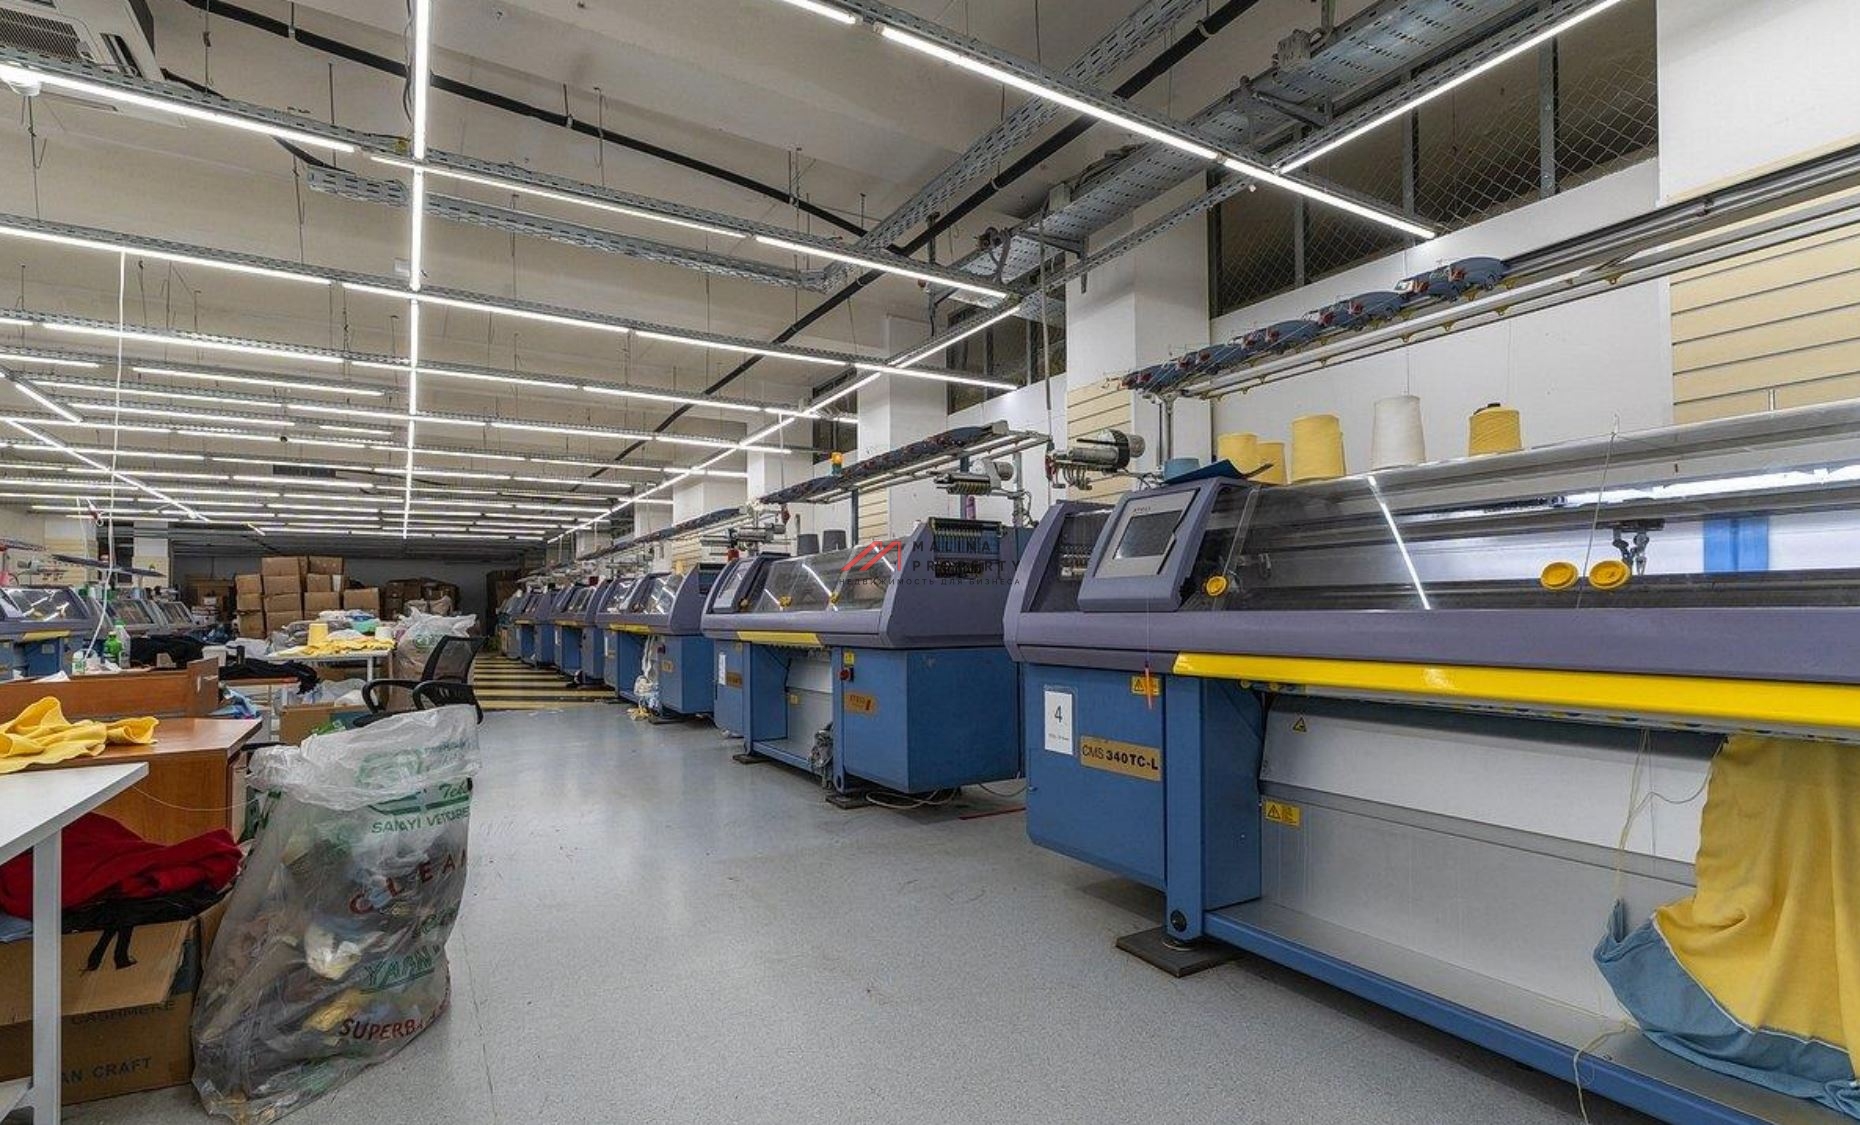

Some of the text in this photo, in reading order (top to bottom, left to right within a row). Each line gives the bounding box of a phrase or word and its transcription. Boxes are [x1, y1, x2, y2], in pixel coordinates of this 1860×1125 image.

[1054, 705, 1063, 723] 4
[1082, 744, 1104, 759] CMS
[61, 1057, 152, 1086] AN CRAFT
